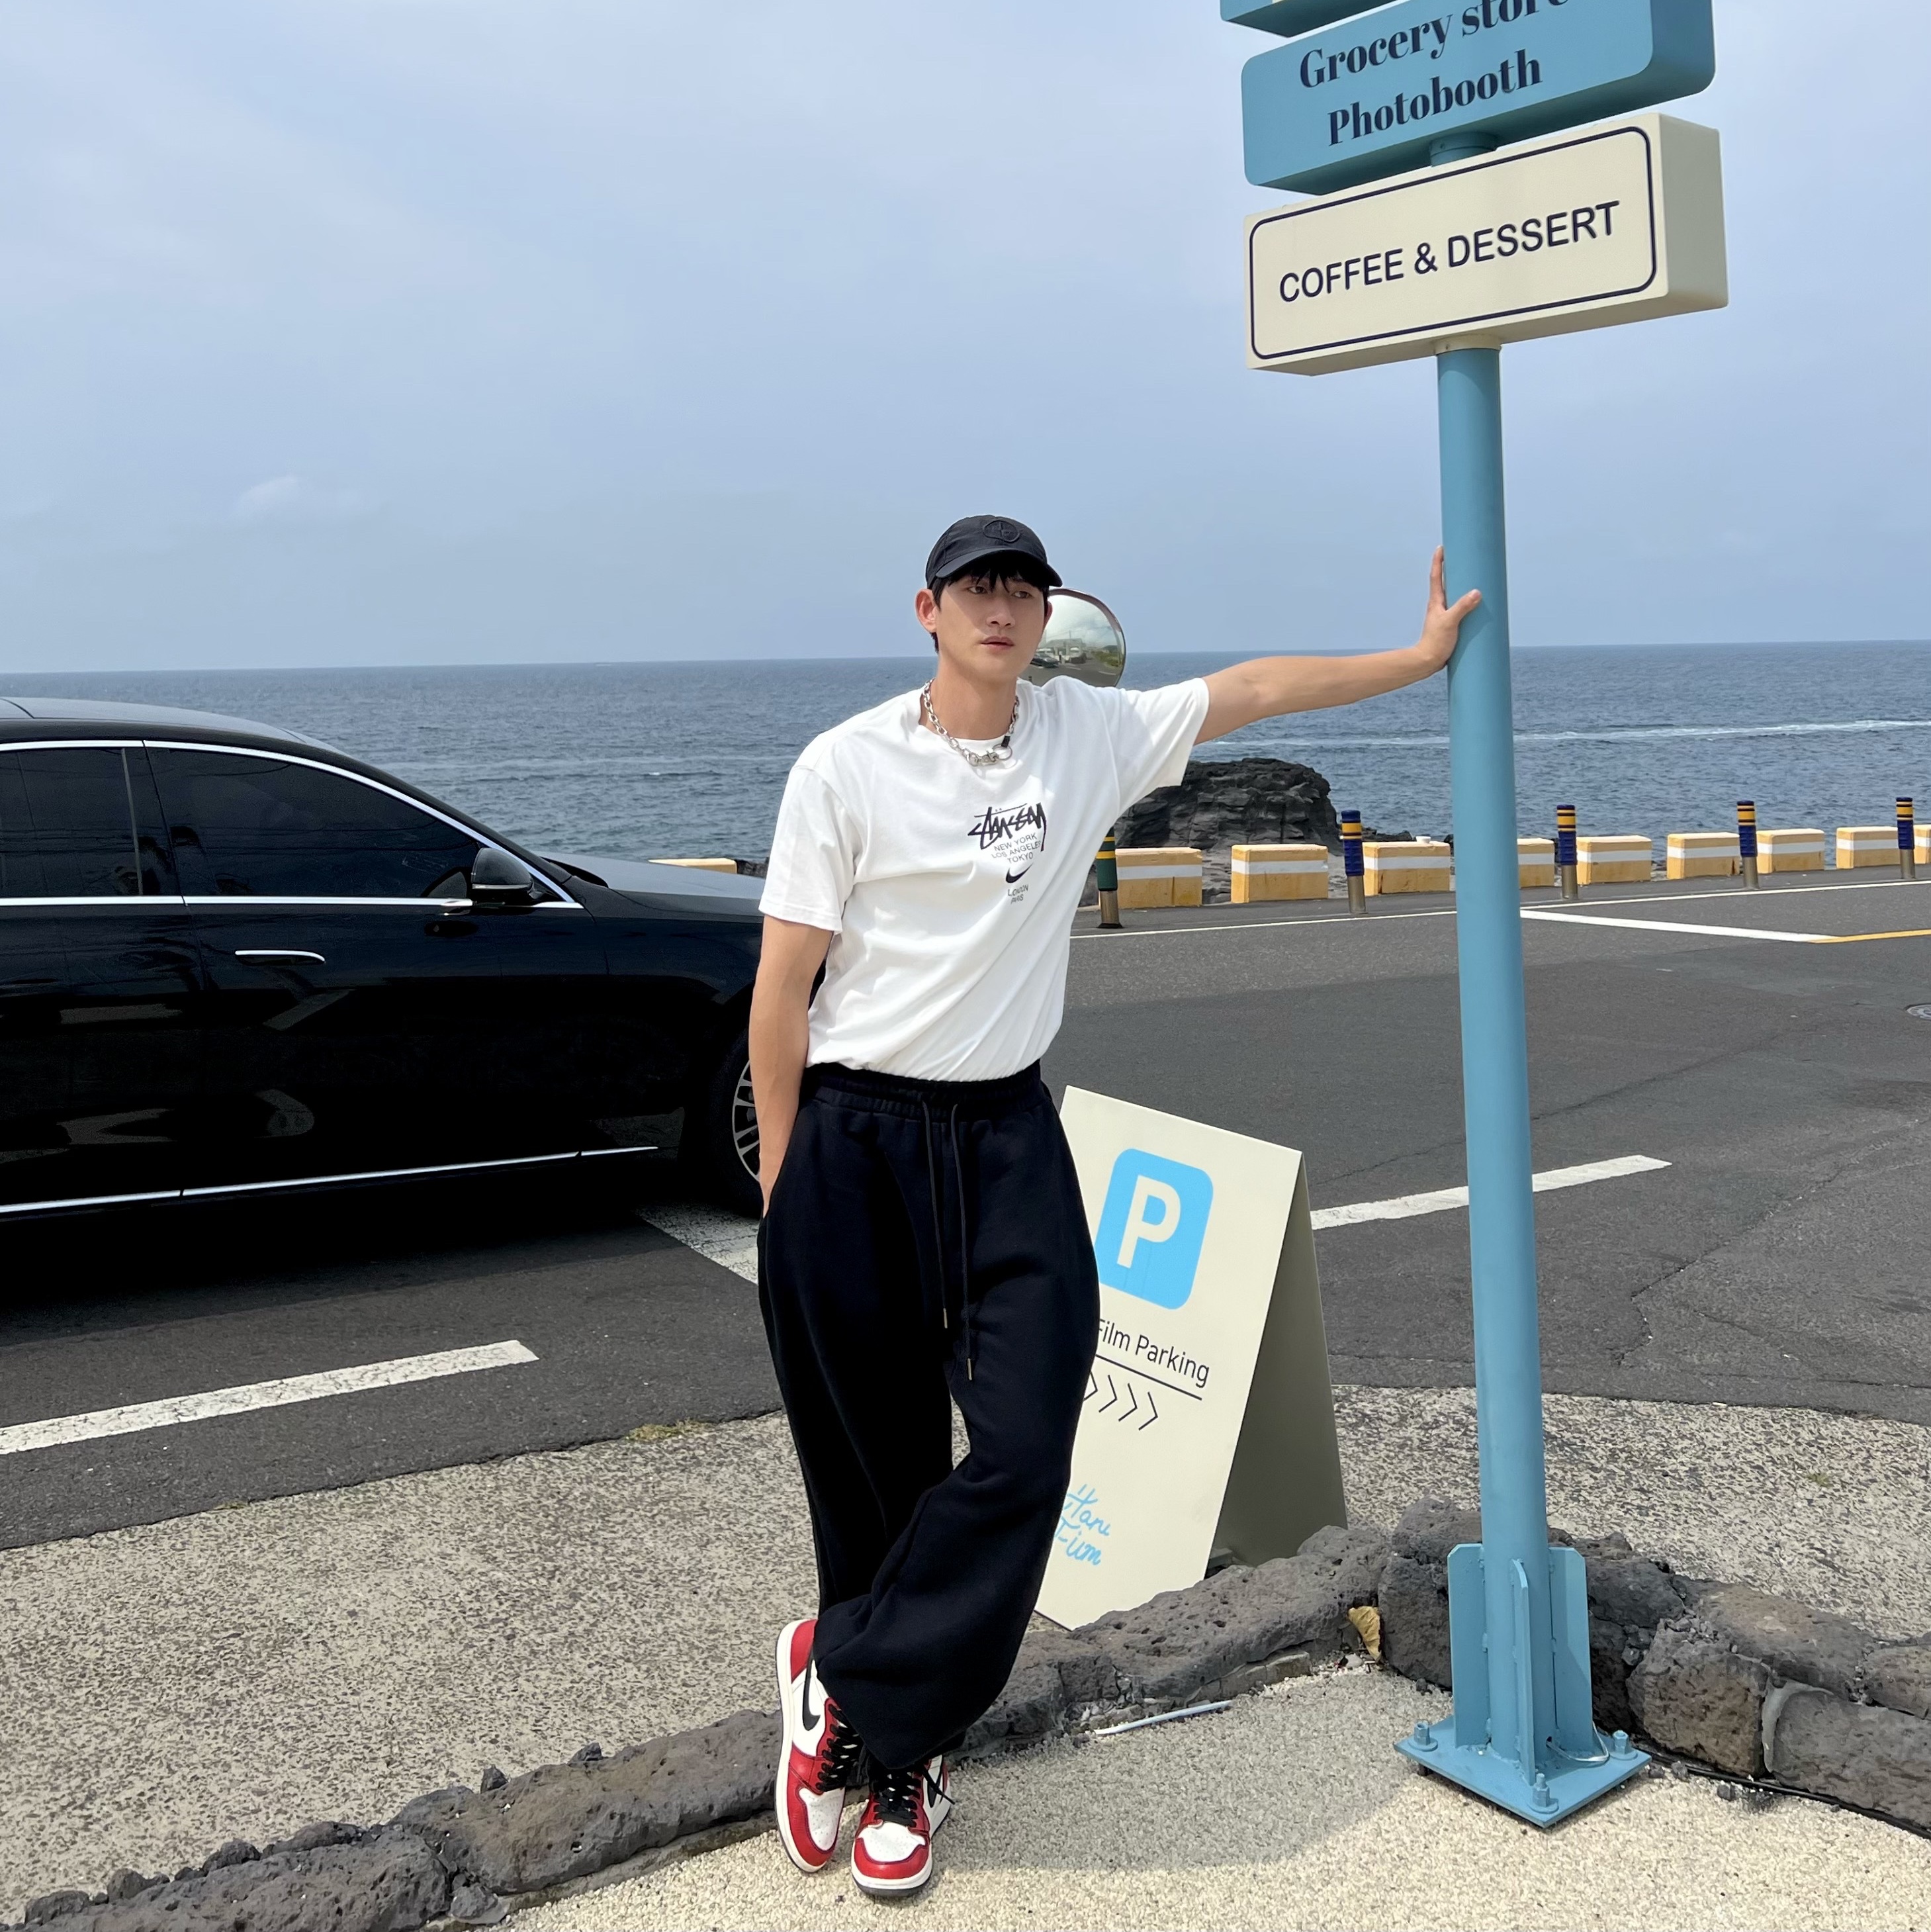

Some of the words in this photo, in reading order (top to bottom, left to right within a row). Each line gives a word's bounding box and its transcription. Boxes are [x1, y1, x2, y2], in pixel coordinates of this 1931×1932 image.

[1300, 14, 1454, 88] Grocery
[1462, 0, 1569, 37] stor
[1327, 48, 1543, 146] Photobooth
[1279, 248, 1405, 302] COFFEE
[1414, 242, 1439, 275] &
[1447, 201, 1621, 267] DESSERT
[991, 851, 1007, 859] LOS
[993, 841, 1012, 852] NEW
[1013, 832, 1038, 845] YORK
[1007, 851, 1034, 864] TOKYO
[1116, 1174, 1181, 1269] P
[1135, 1334, 1210, 1389] Parking
